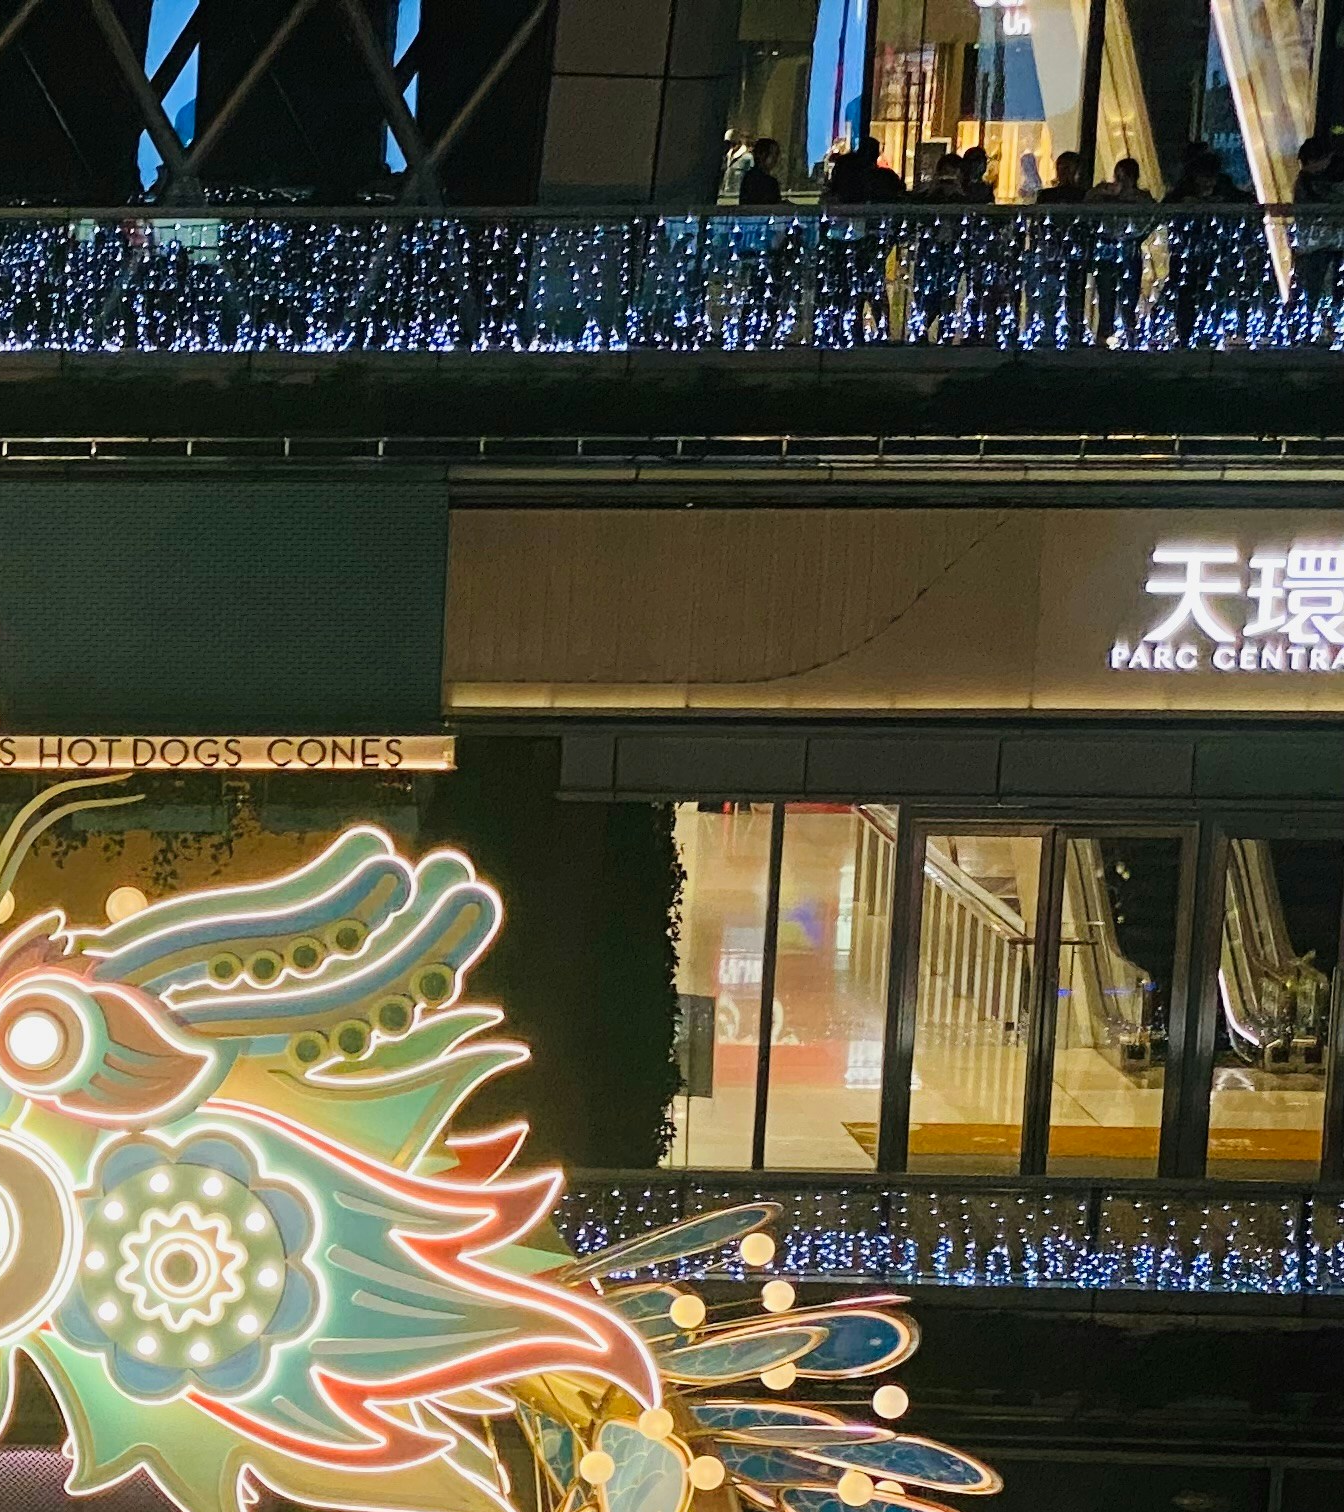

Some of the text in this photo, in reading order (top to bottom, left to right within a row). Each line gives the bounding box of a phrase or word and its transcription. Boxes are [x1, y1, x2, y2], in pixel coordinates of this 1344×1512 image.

[1109, 642, 1199, 671] PARC
[39, 737, 122, 767] HOT
[132, 737, 243, 767] DOGS
[267, 737, 404, 767] CONES
